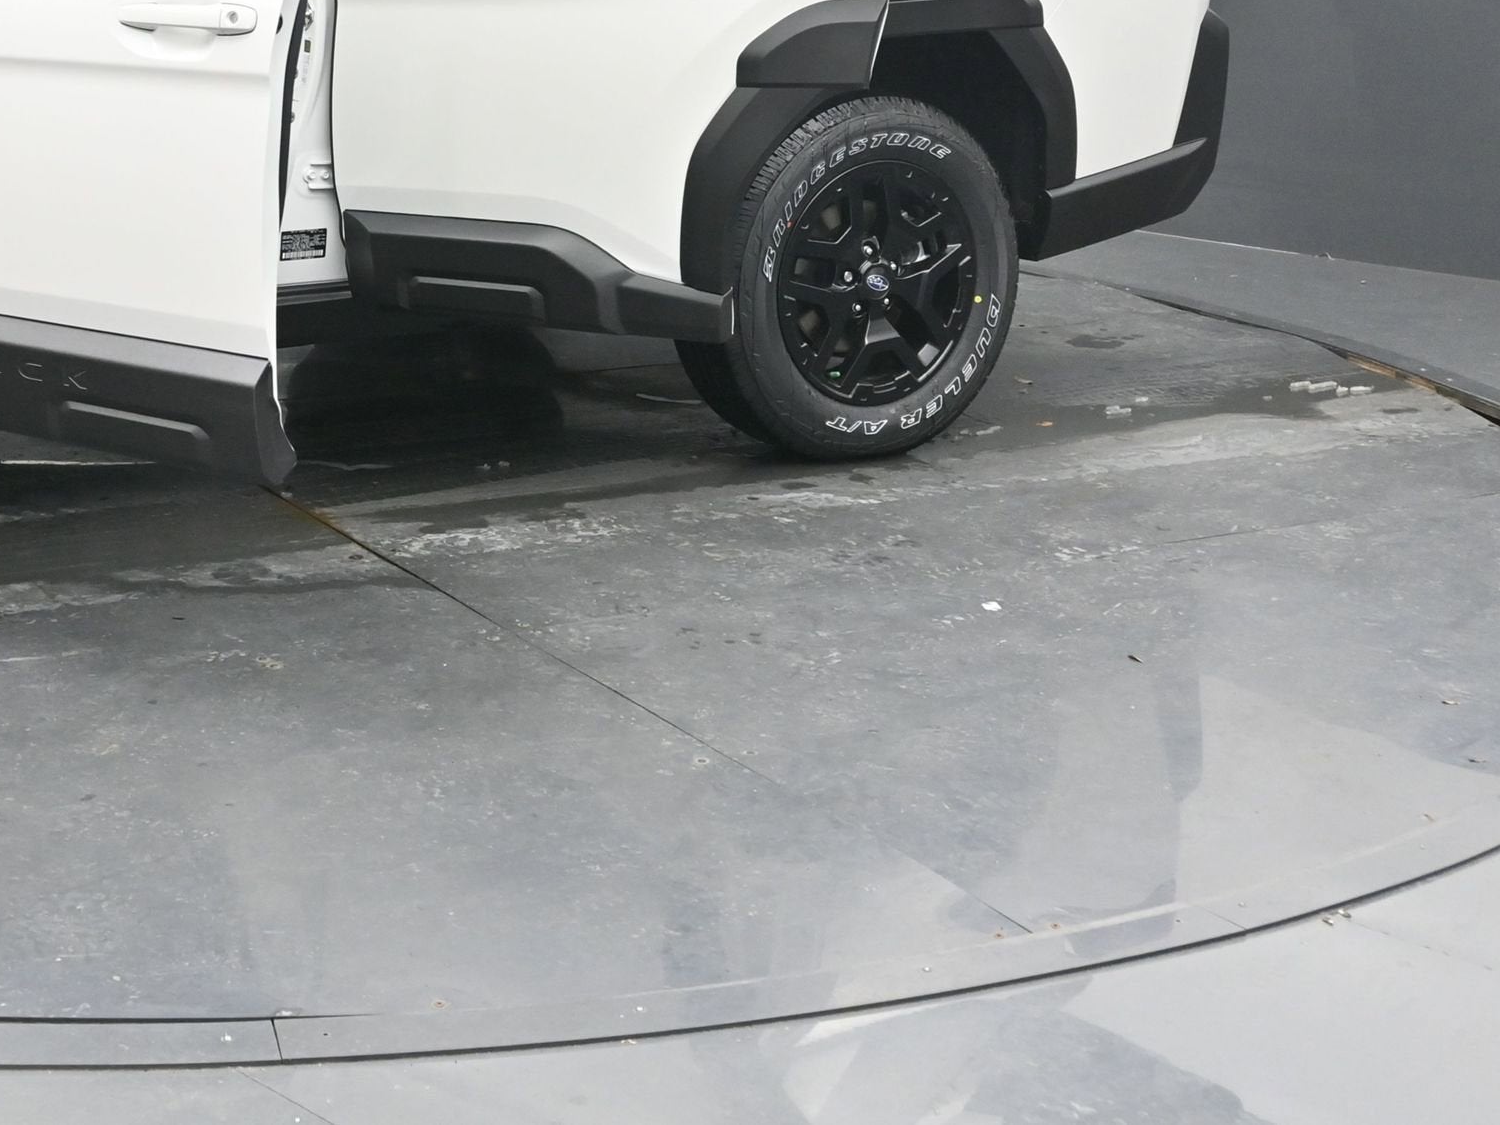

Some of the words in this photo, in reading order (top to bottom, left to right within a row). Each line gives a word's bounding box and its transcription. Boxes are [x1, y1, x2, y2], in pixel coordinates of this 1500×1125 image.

[763, 132, 951, 282] BRIDGESTONE
[825, 416, 888, 435] A/T
[901, 293, 1001, 429] DUELER
